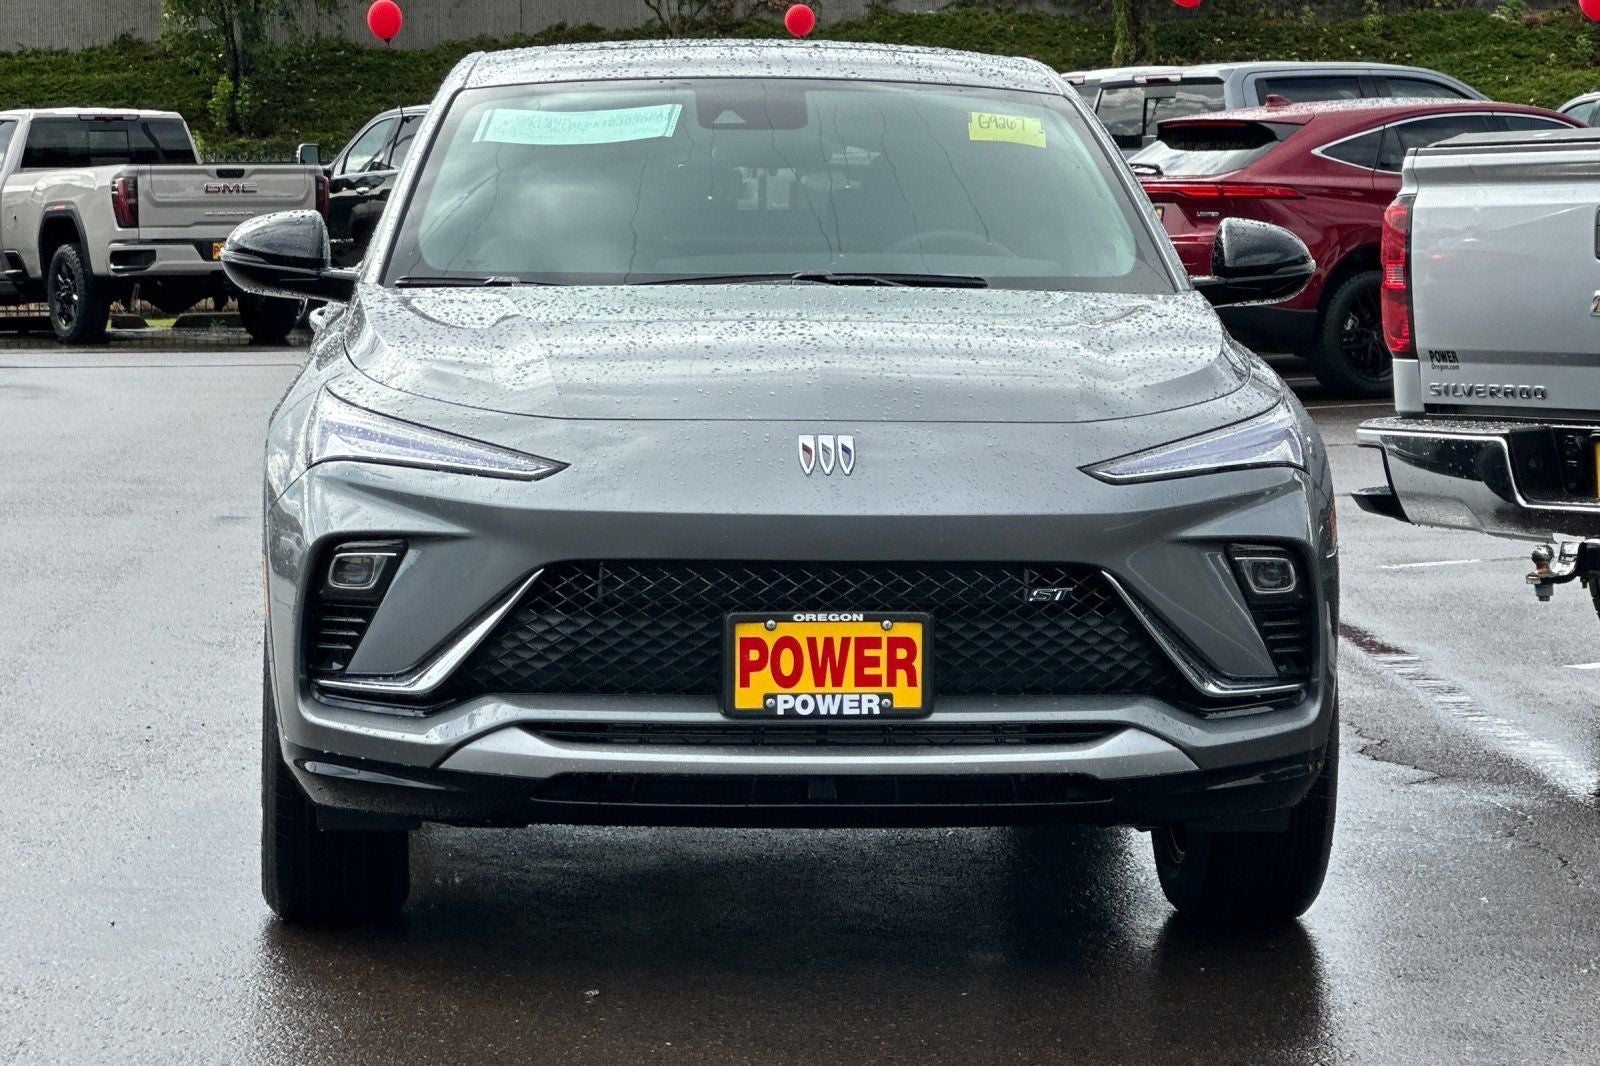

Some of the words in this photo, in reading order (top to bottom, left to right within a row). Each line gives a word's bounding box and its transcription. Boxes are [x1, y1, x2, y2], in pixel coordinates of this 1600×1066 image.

[203, 183, 258, 194] GMC
[1429, 350, 1459, 363] POWER
[1429, 382, 1548, 400] SILVERADO
[1029, 587, 1073, 602] ST
[793, 613, 864, 622] OREGON
[739, 635, 918, 689] POWER
[776, 694, 881, 716] POWER
